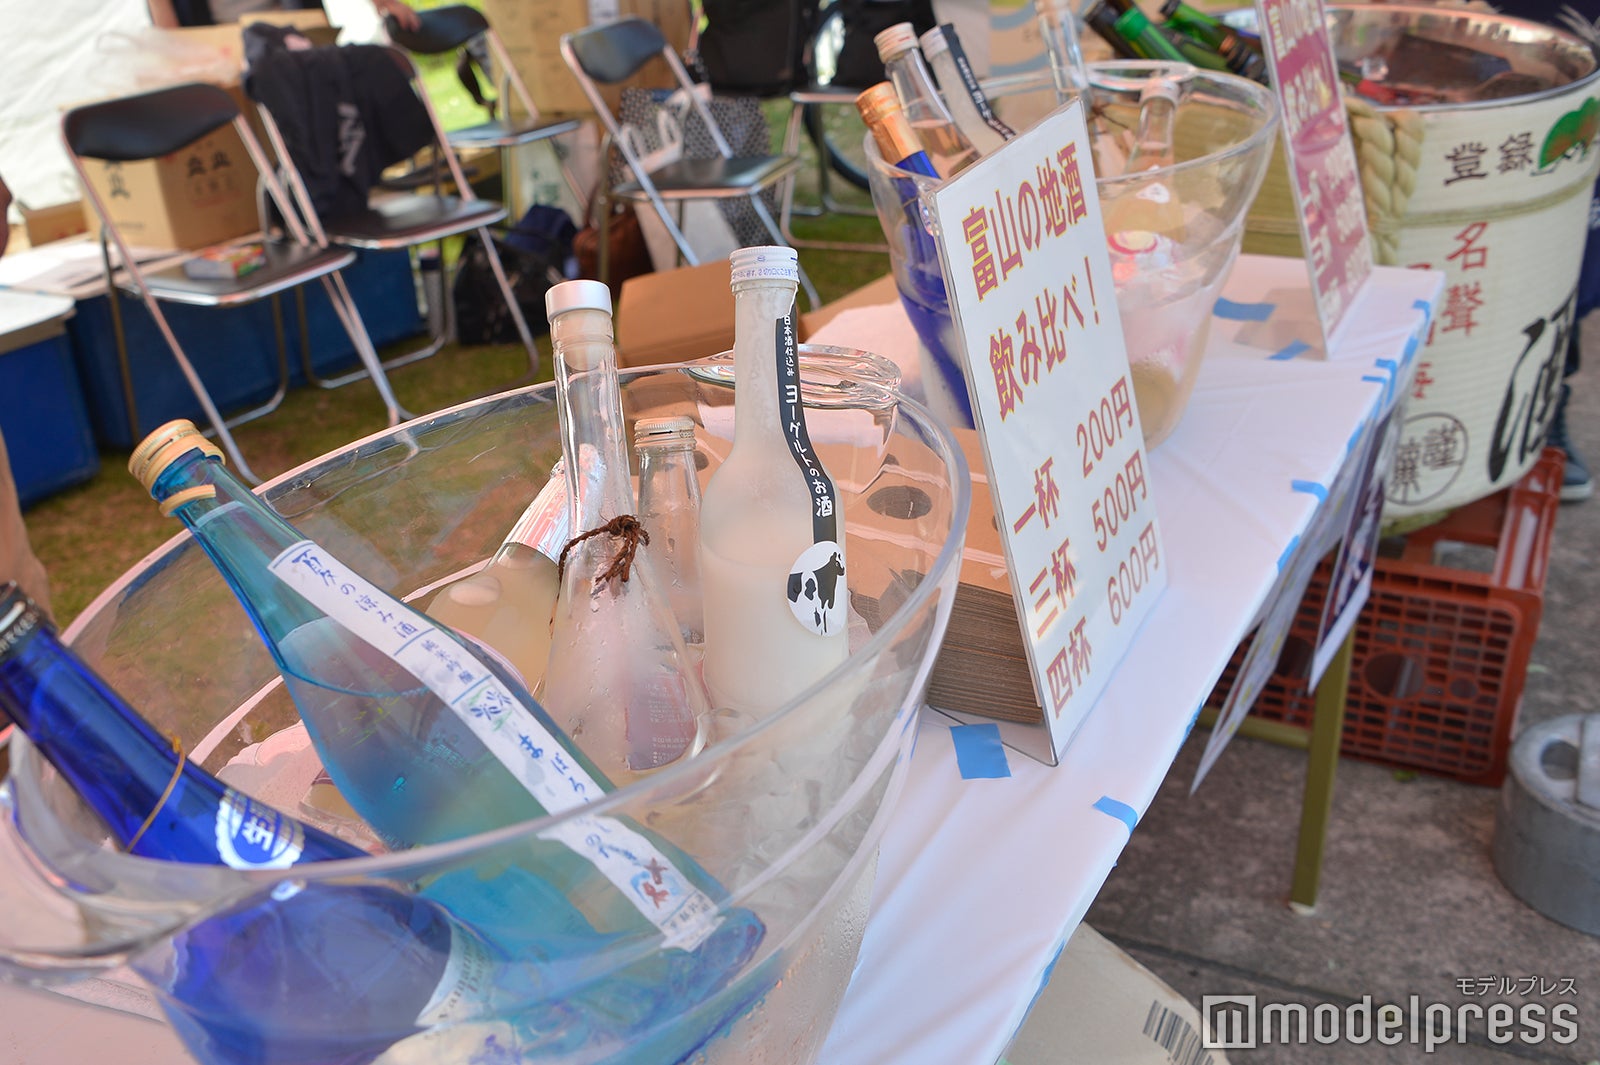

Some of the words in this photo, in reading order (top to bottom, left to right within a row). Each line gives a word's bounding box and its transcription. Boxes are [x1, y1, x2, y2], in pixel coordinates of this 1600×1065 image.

[961, 140, 1088, 303] 富山の地酒
[783, 314, 796, 377] 日本酒仕込み
[784, 384, 834, 518] ヨーグルトのお酒
[1013, 456, 1061, 535] 一杯
[1076, 375, 1134, 479] 200円
[290, 548, 420, 640] 夏の涼み酒
[1029, 537, 1077, 640] 三杯
[1091, 449, 1148, 552] 500円
[1046, 616, 1092, 720] 四杯
[1107, 520, 1161, 626] 600円
